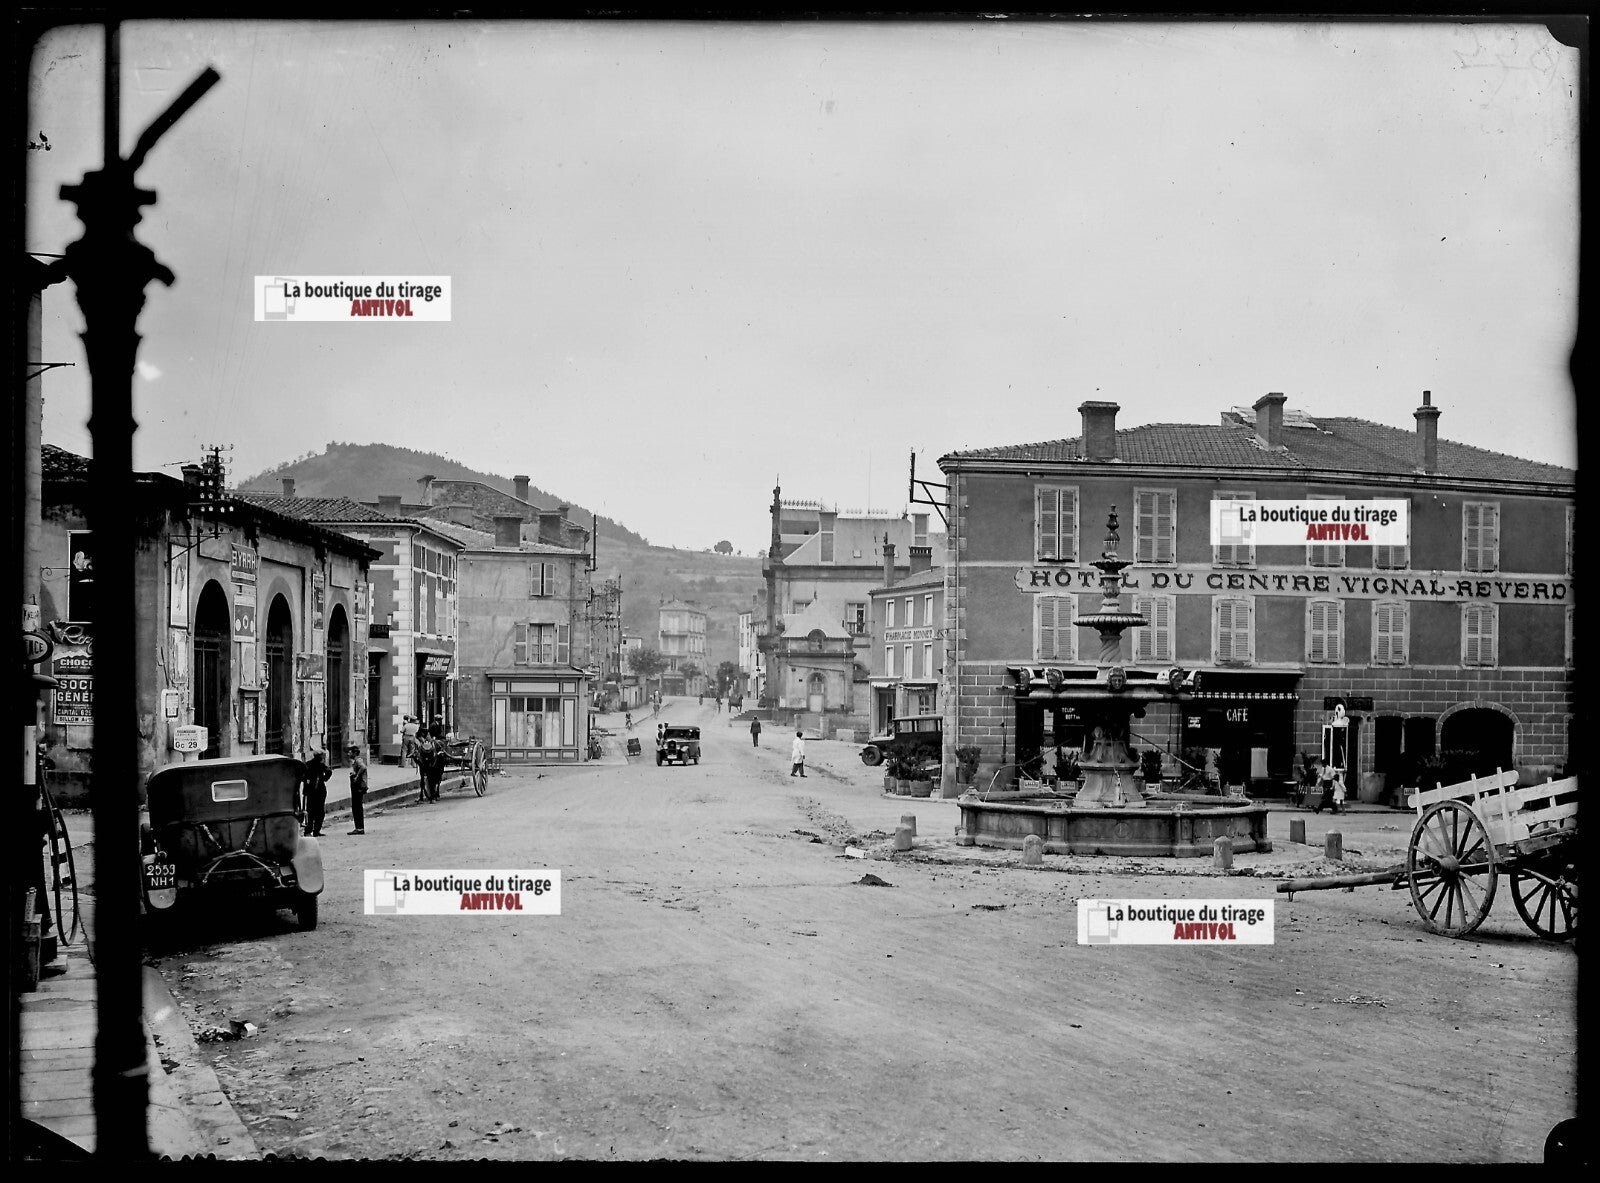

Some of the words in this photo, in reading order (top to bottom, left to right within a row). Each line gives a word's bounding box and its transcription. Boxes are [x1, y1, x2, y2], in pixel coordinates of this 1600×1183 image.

[232, 551, 256, 569] BYRRH
[1151, 572, 1194, 588] DU
[1206, 573, 1330, 592] CENTRE
[1226, 706, 1249, 722] CAFÉ
[188, 741, 198, 749] 29
